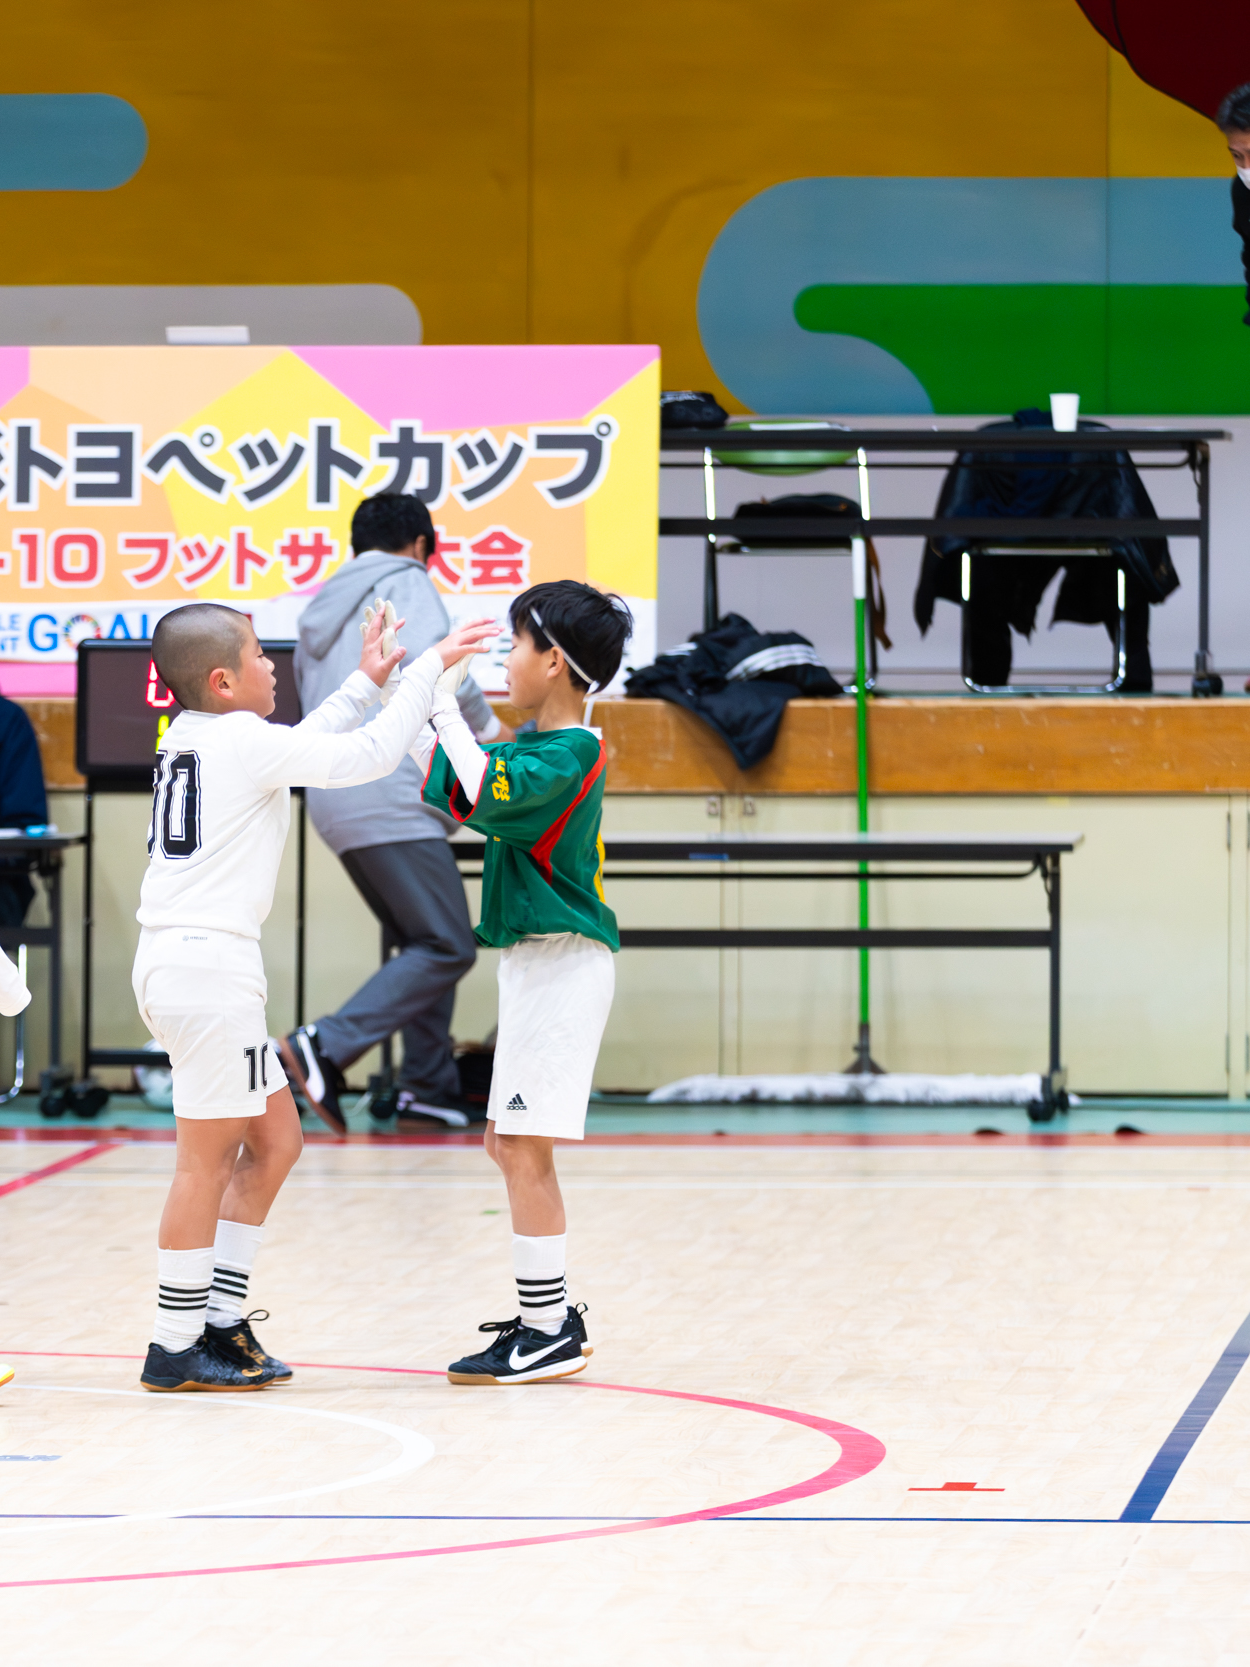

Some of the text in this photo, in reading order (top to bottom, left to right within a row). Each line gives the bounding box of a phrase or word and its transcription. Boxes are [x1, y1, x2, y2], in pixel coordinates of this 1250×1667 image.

[123, 530, 524, 586] フットサ大会
